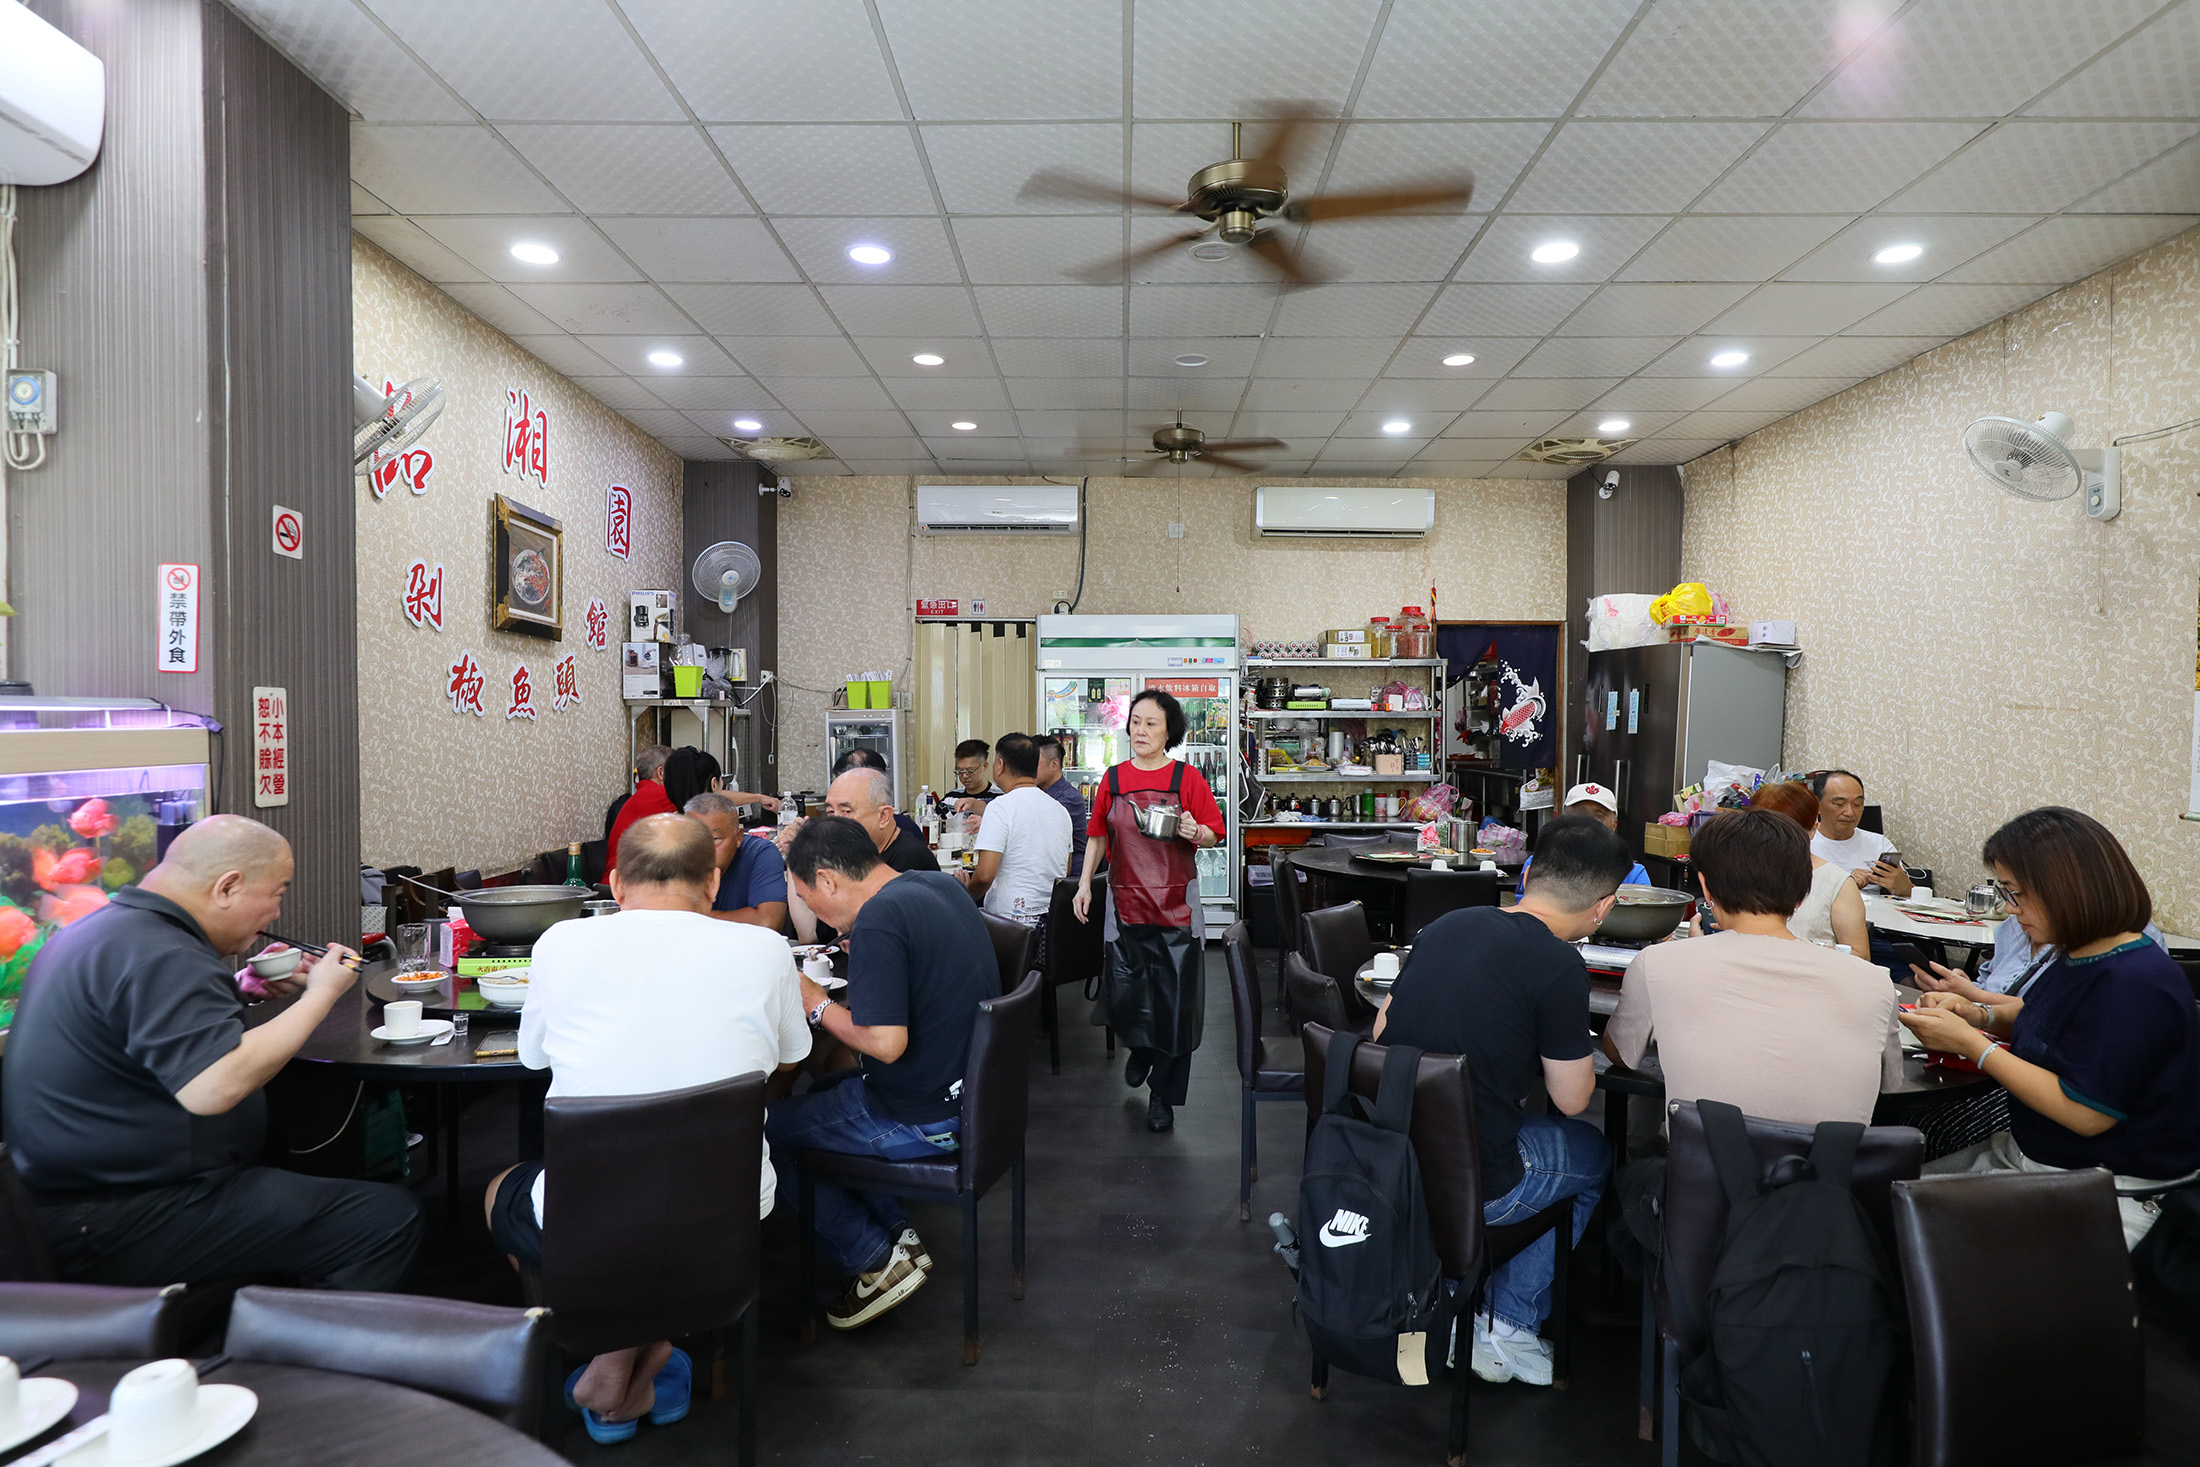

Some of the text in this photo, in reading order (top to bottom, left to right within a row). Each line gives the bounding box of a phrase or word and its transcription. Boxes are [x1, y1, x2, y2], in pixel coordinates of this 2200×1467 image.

[169, 592, 187, 664] 禁帶外食
[920, 599, 956, 609] 緊急出口
[258, 697, 272, 796] 恕不賒欠
[272, 697, 285, 795] 小本經營
[1329, 1208, 1369, 1236] NIKE
